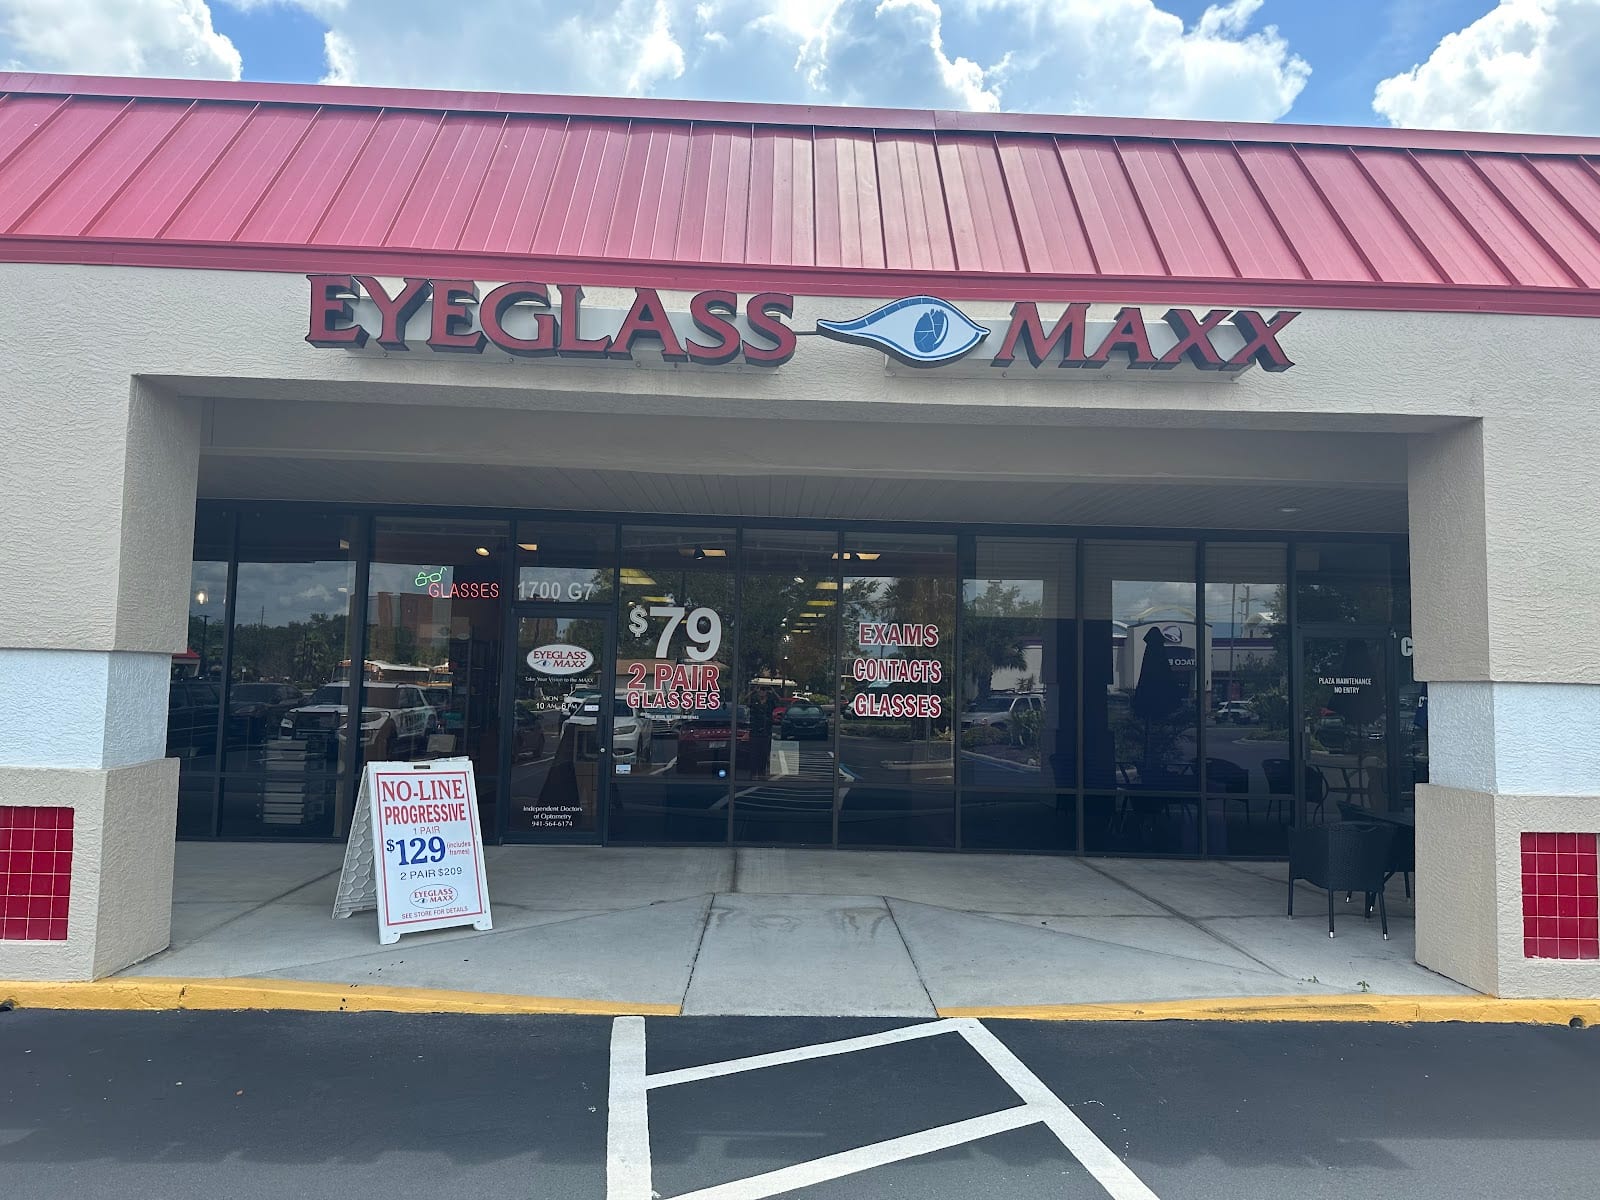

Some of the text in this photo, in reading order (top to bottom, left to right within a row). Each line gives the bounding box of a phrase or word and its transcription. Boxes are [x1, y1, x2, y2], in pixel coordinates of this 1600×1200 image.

[304, 274, 1302, 373] EYEGLASS MAXX
[428, 583, 500, 599] GLASSES
[518, 581, 595, 600] 1700 G7
[628, 604, 722, 662] $79
[859, 622, 939, 648] EXAMS
[533, 650, 587, 668] EYEGLASS MAXX
[627, 662, 720, 692] 2 PAIR
[853, 658, 942, 684] CONTACTS
[1318, 677, 1372, 686] PLAZA MAINTENANCE
[1334, 686, 1342, 694] NO
[536, 702, 545, 710] 10
[561, 702, 567, 710] 6
[626, 690, 721, 710] GLASSES
[853, 693, 942, 719] GLASSES
[381, 779, 465, 802] NO-LINE
[384, 803, 467, 825] PROGRESSIVE
[540, 813, 572, 821] Optometry
[413, 825, 441, 835] 1 PAIR
[386, 836, 446, 866] $129
[400, 866, 463, 880] 2 PAIR $209
[414, 888, 454, 903] EYEGLASS MAXX
[401, 905, 469, 920] SEE STORE FOR DETAILS
